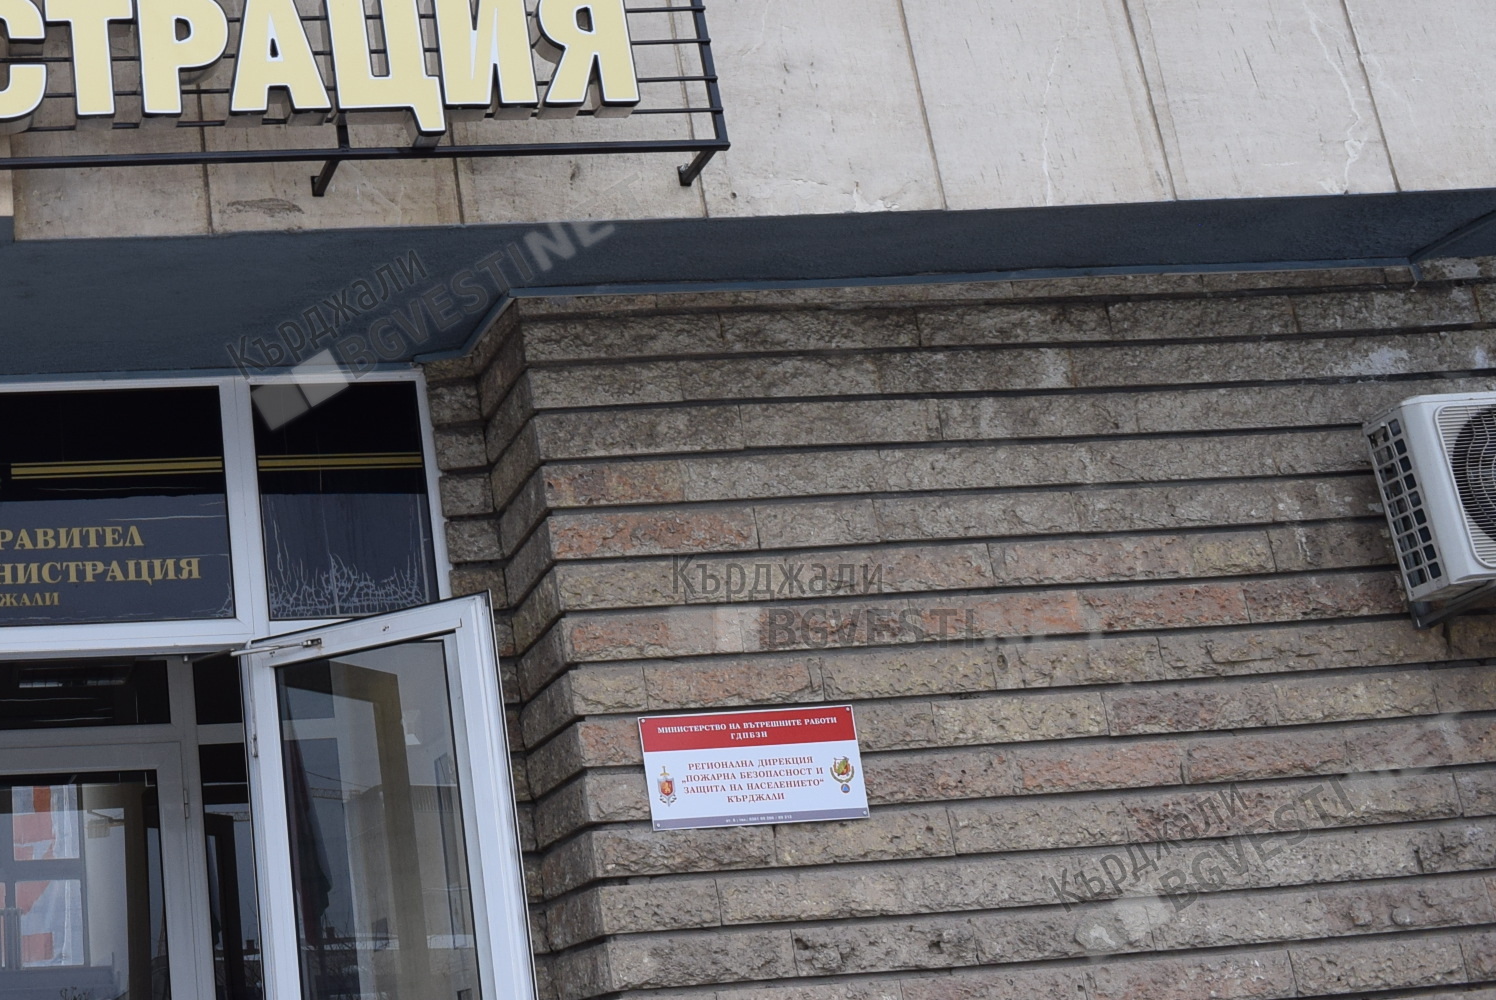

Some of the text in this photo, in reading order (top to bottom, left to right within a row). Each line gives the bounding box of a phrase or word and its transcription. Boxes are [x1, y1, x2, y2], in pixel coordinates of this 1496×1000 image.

[657, 716, 837, 734] МИНИСТЕРСТВО НА ВЪТРЕШНИТЕ РАБОТИ
[688, 756, 813, 771] РЕГИОНАЛНА ДИРЕКЦИЯ
[740, 768, 812, 779] БЕЗОПАСНОСТ
[816, 767, 824, 775] И
[684, 785, 726, 795] ЗАЩИТА
[730, 783, 743, 792] НА
[727, 792, 785, 803] КЪРДЖАЛИ
